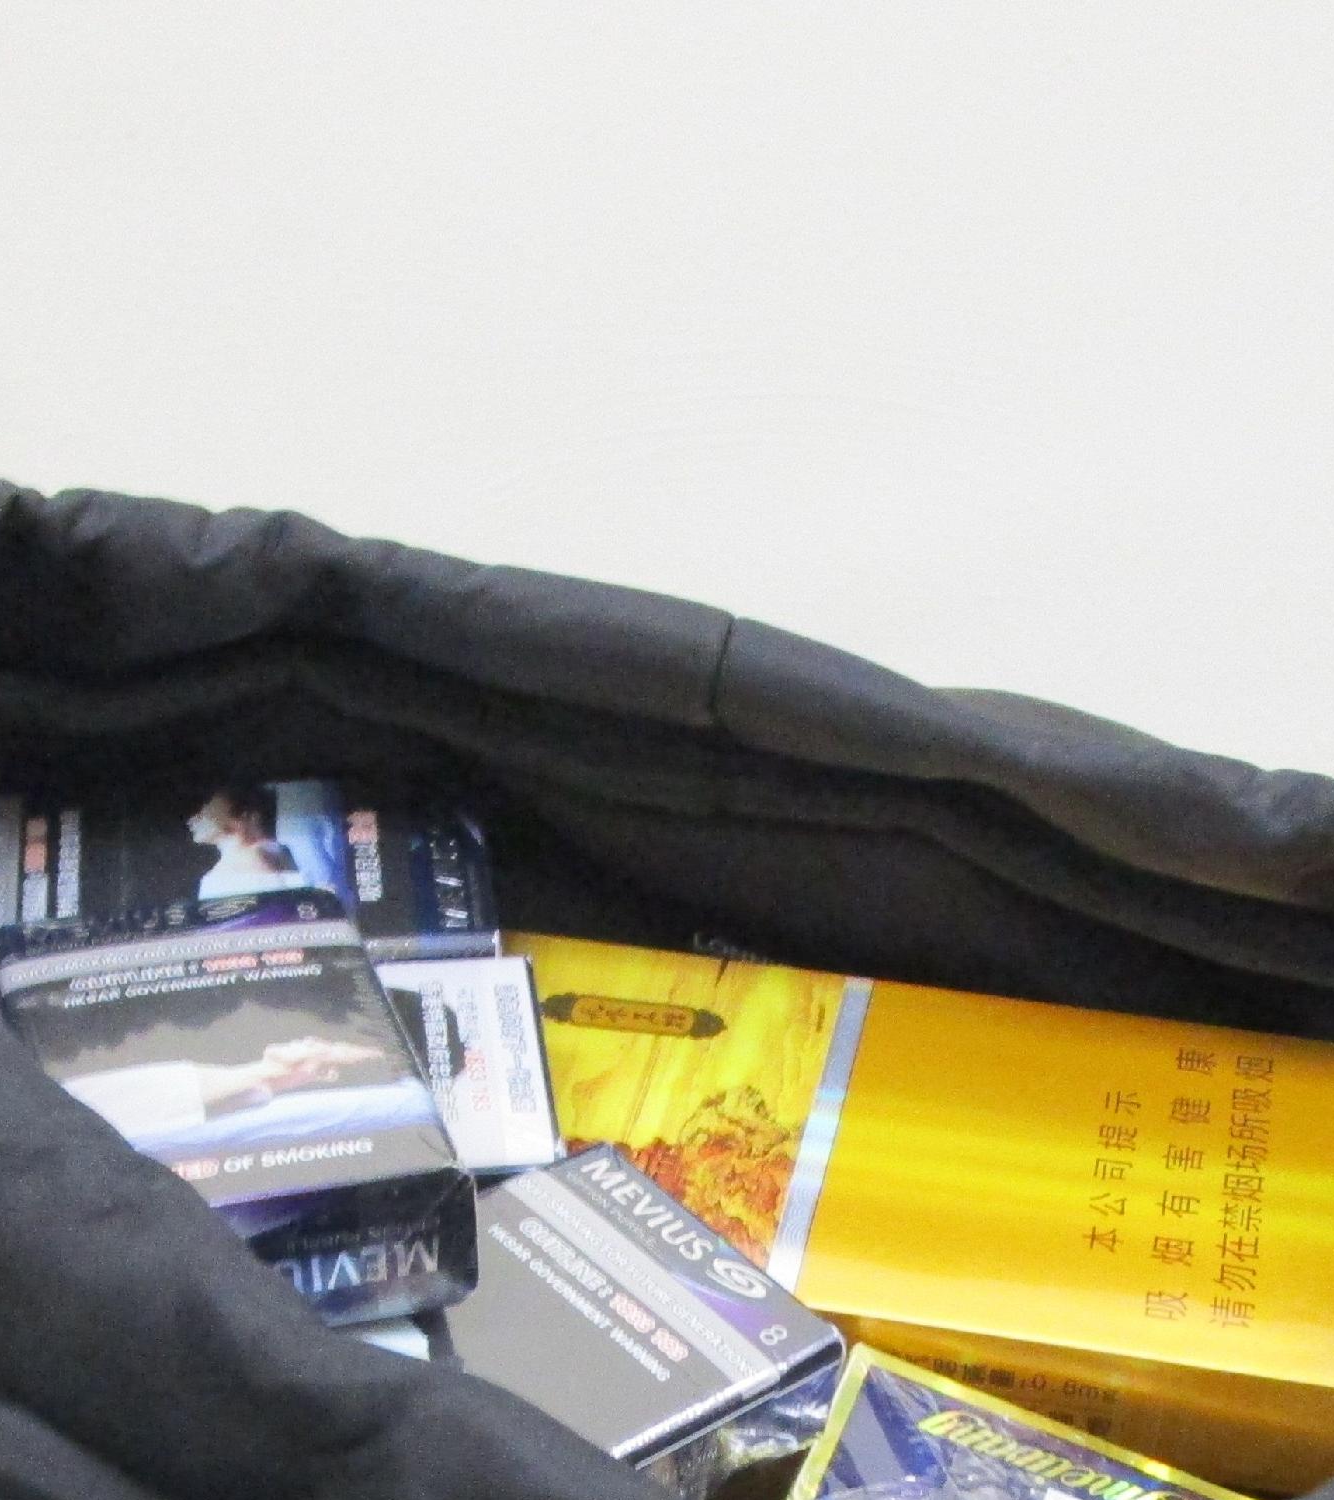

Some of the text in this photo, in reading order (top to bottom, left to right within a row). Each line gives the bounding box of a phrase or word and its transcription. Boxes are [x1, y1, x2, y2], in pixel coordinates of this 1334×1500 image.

[125, 970, 237, 998] GOVERNMENT
[243, 963, 324, 983] WARNING
[223, 1153, 255, 1174] OF
[261, 1137, 374, 1168] SMOKING
[580, 1158, 714, 1261] MEVIUS
[1082, 1089, 1141, 1254] 本公司提示
[1144, 1046, 1218, 1322] 吸烟有害健康
[1209, 1054, 1275, 1329] 请勿在禁烟场所吸烟
[488, 1222, 532, 1262] HKSAR
[529, 1257, 612, 1329] GOVERNMENT
[610, 1325, 671, 1382] WARNING
[759, 1325, 788, 1346] 8
